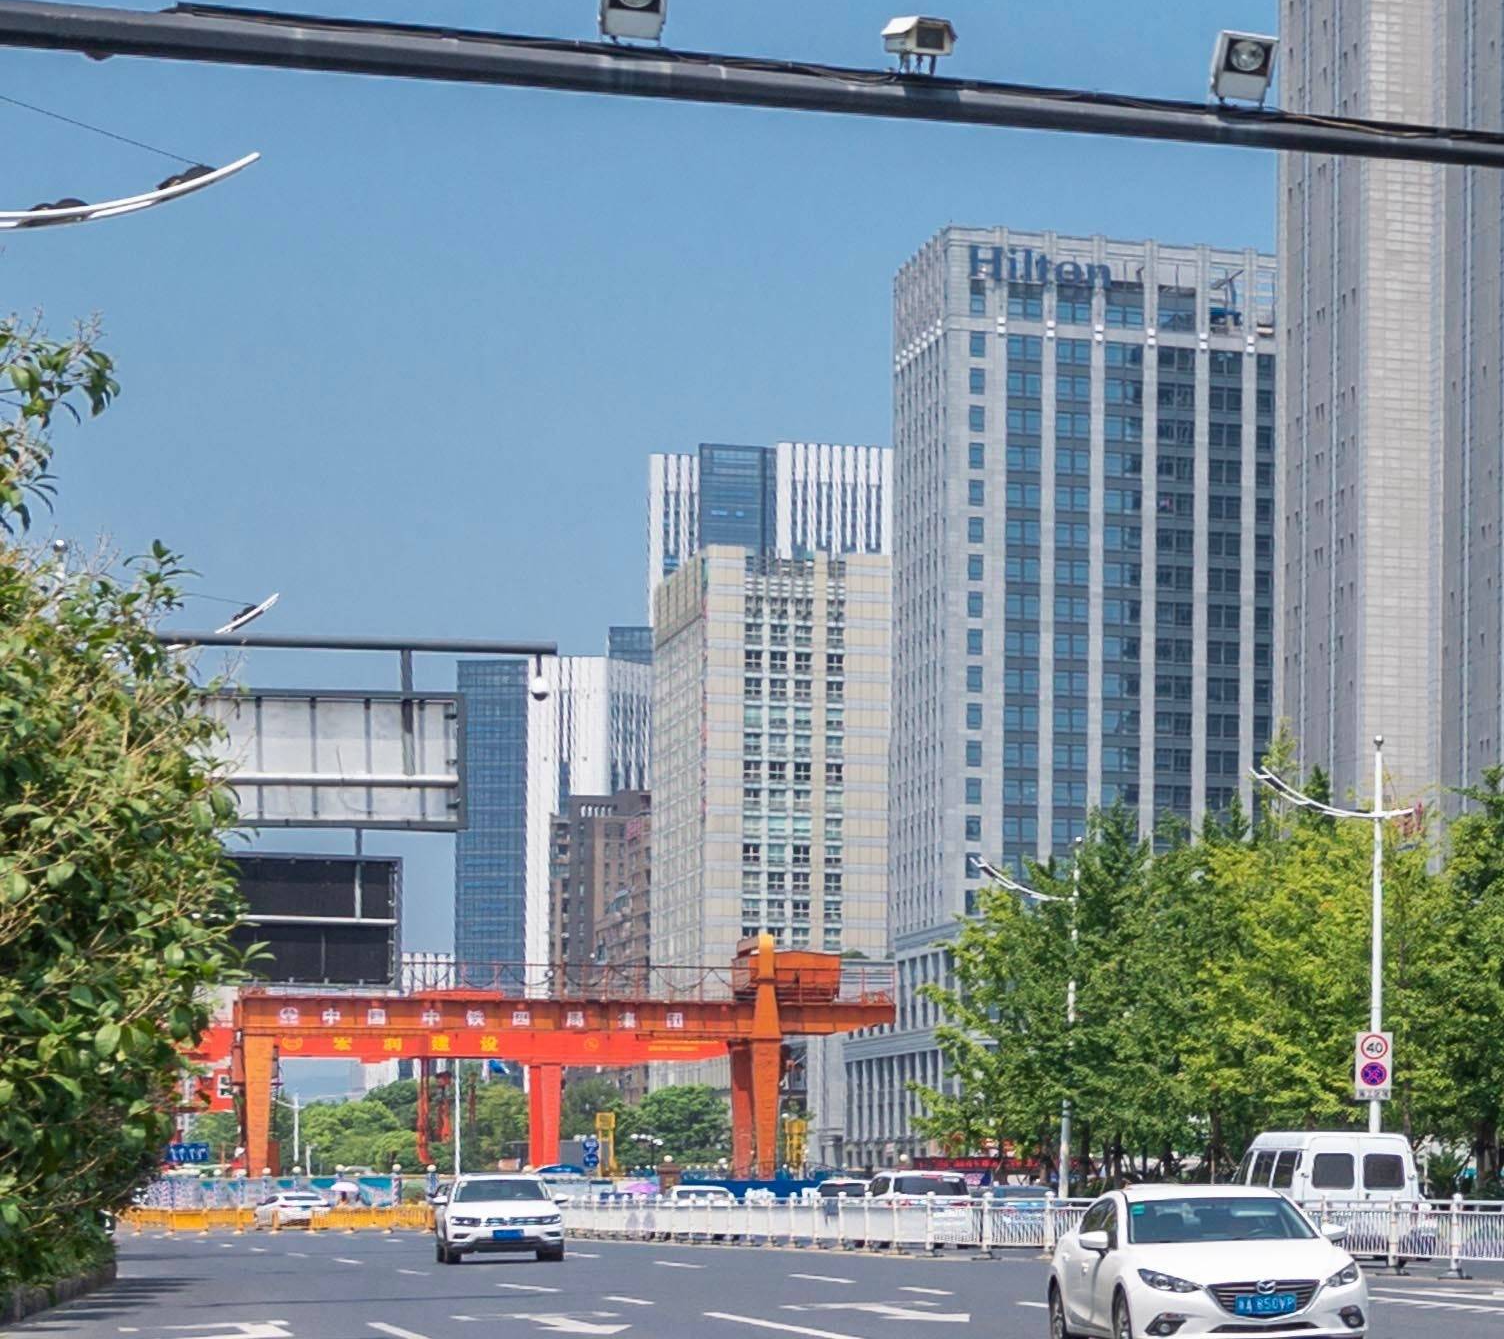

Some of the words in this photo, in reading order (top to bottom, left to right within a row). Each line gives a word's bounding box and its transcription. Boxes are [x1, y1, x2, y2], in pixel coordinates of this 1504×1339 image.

[968, 245, 1112, 289] Hilton
[322, 1008, 684, 1028] 中国中铁四局集团
[1366, 1042, 1383, 1053] 40
